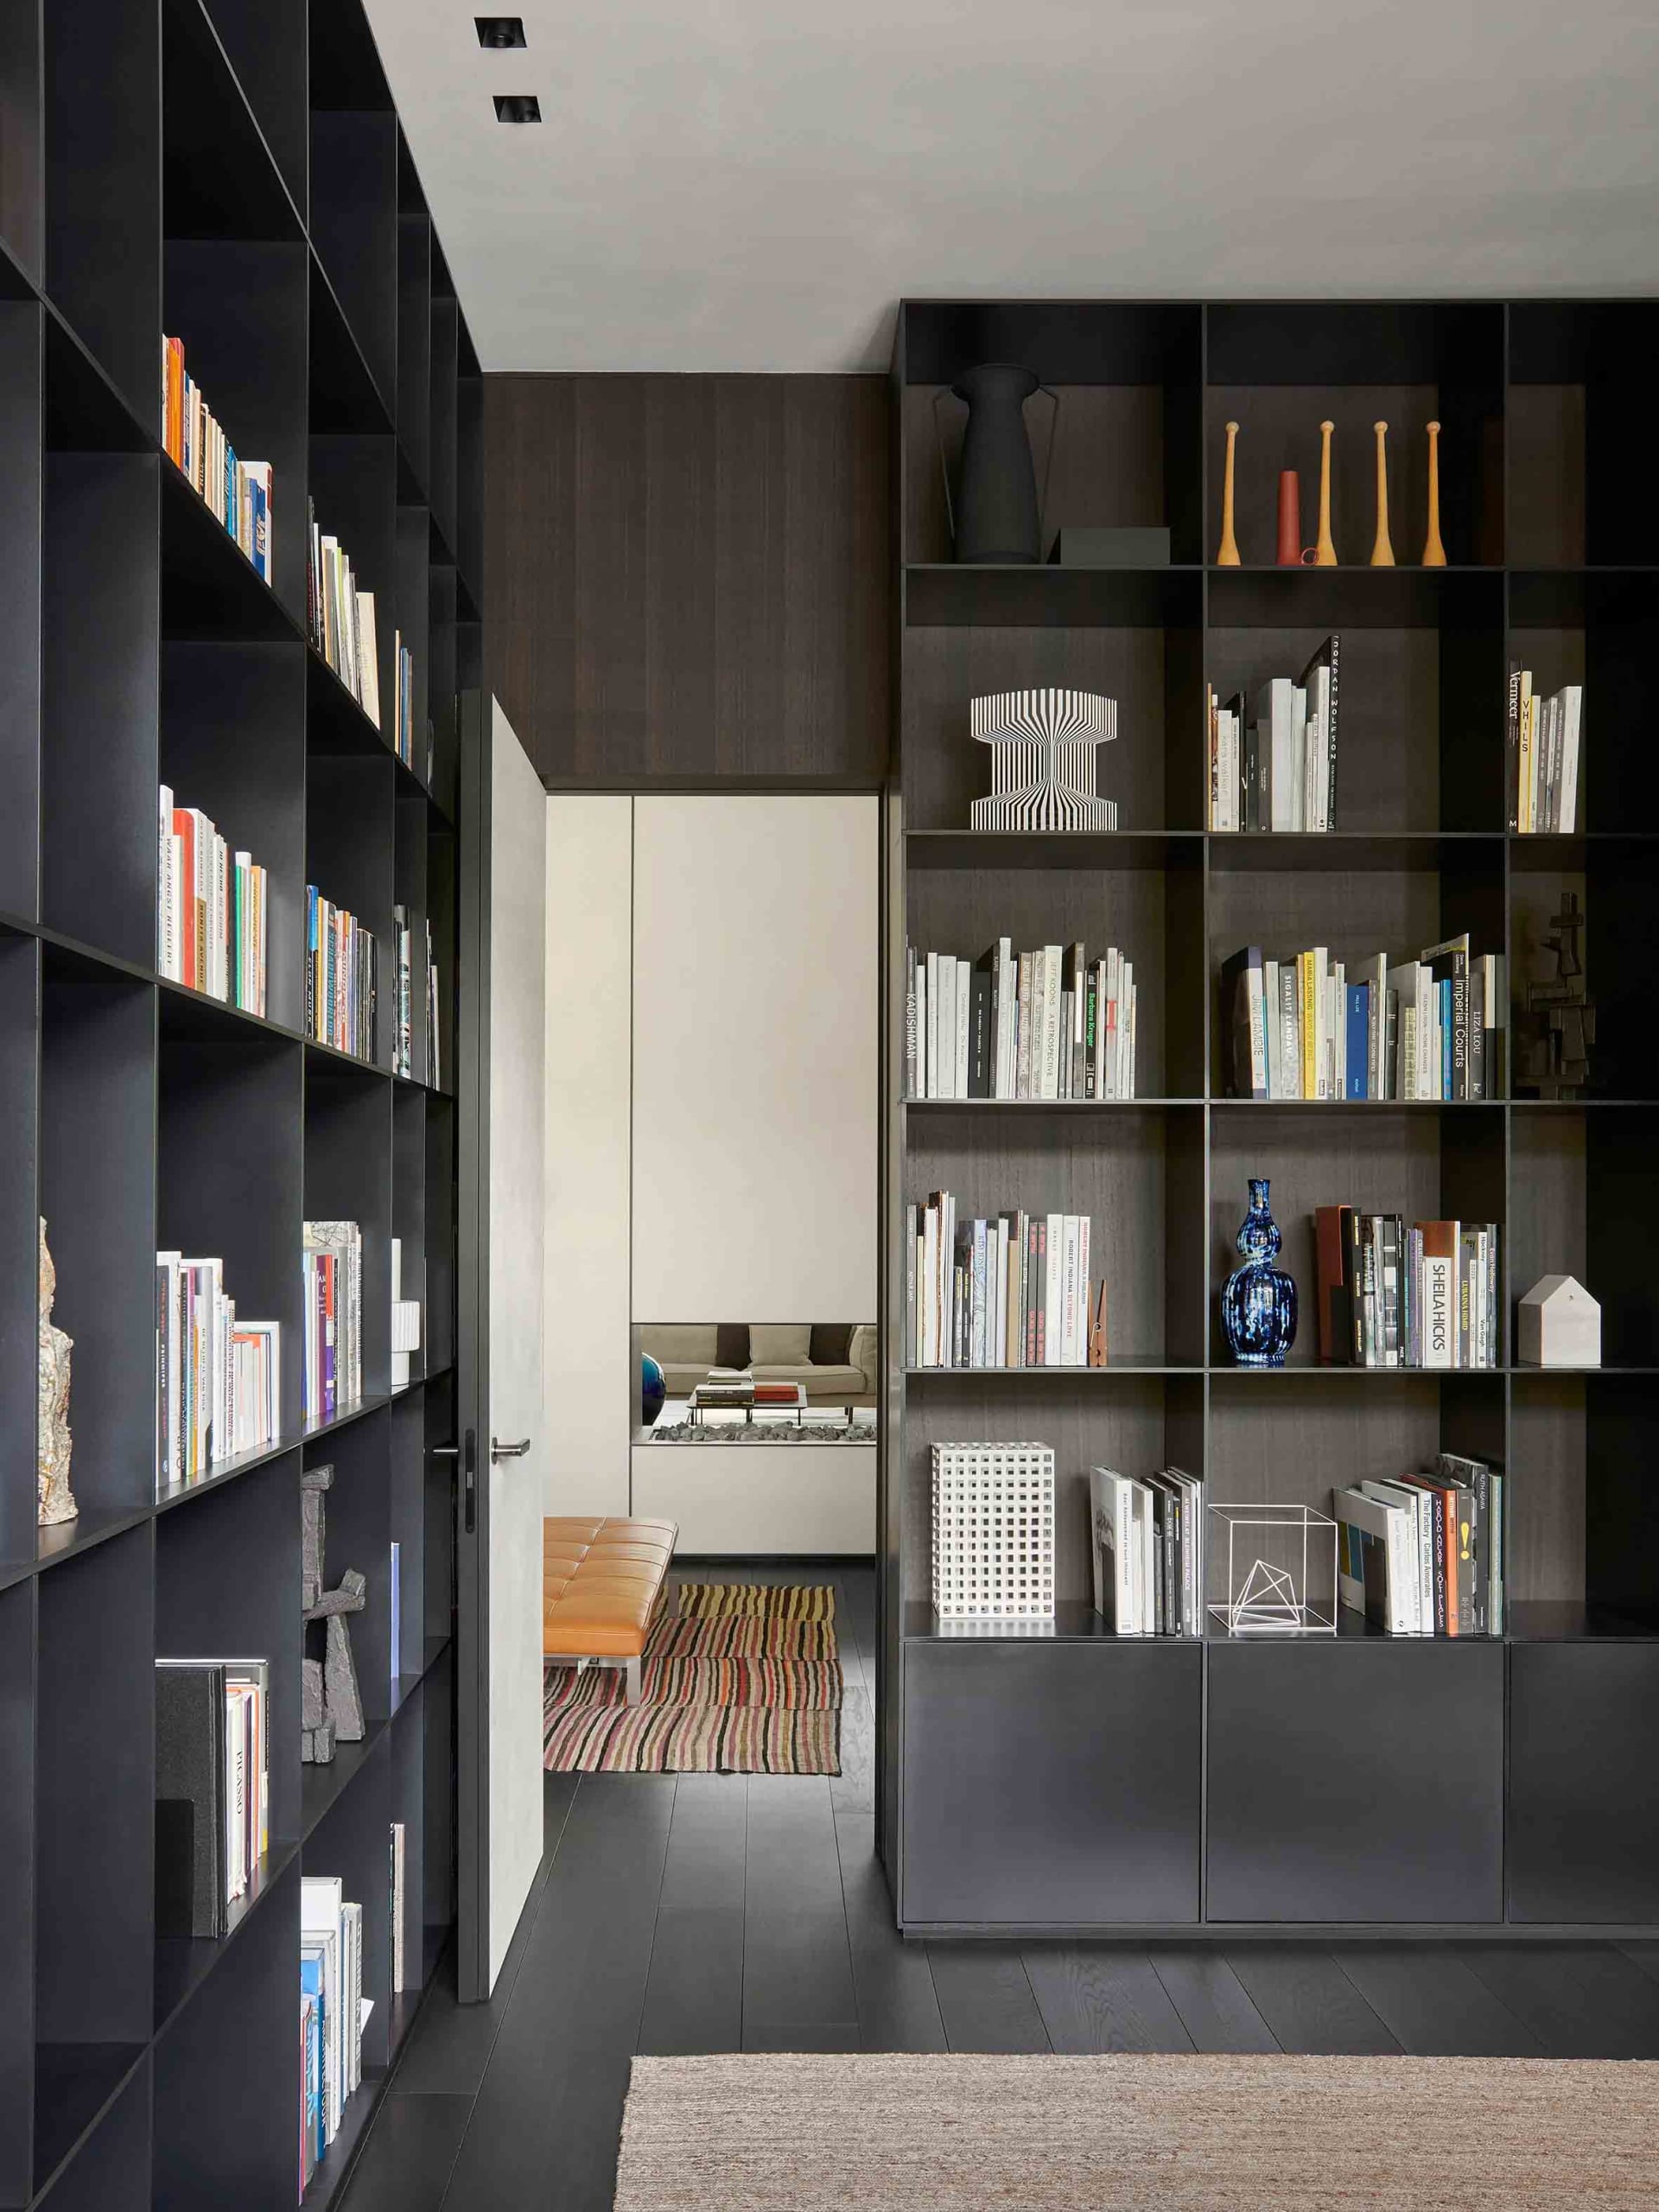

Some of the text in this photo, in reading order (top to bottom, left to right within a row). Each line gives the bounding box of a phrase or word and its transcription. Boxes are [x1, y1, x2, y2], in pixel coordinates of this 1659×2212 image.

[1510, 671, 1521, 719] Vermeer
[1048, 978, 1057, 1006] KOONS
[1453, 979, 1466, 1024] Imperial
[906, 994, 916, 1058] KADISHMAN
[1251, 995, 1263, 1055] JIM LAMBIE
[1046, 1020, 1056, 1077] RETROSPECTIVE
[1455, 1029, 1465, 1068] Courts
[1433, 1264, 1446, 1351] SHEILA HICKS
[1421, 1512, 1431, 1537] Factory
[1424, 1566, 1433, 1598] Amorales
